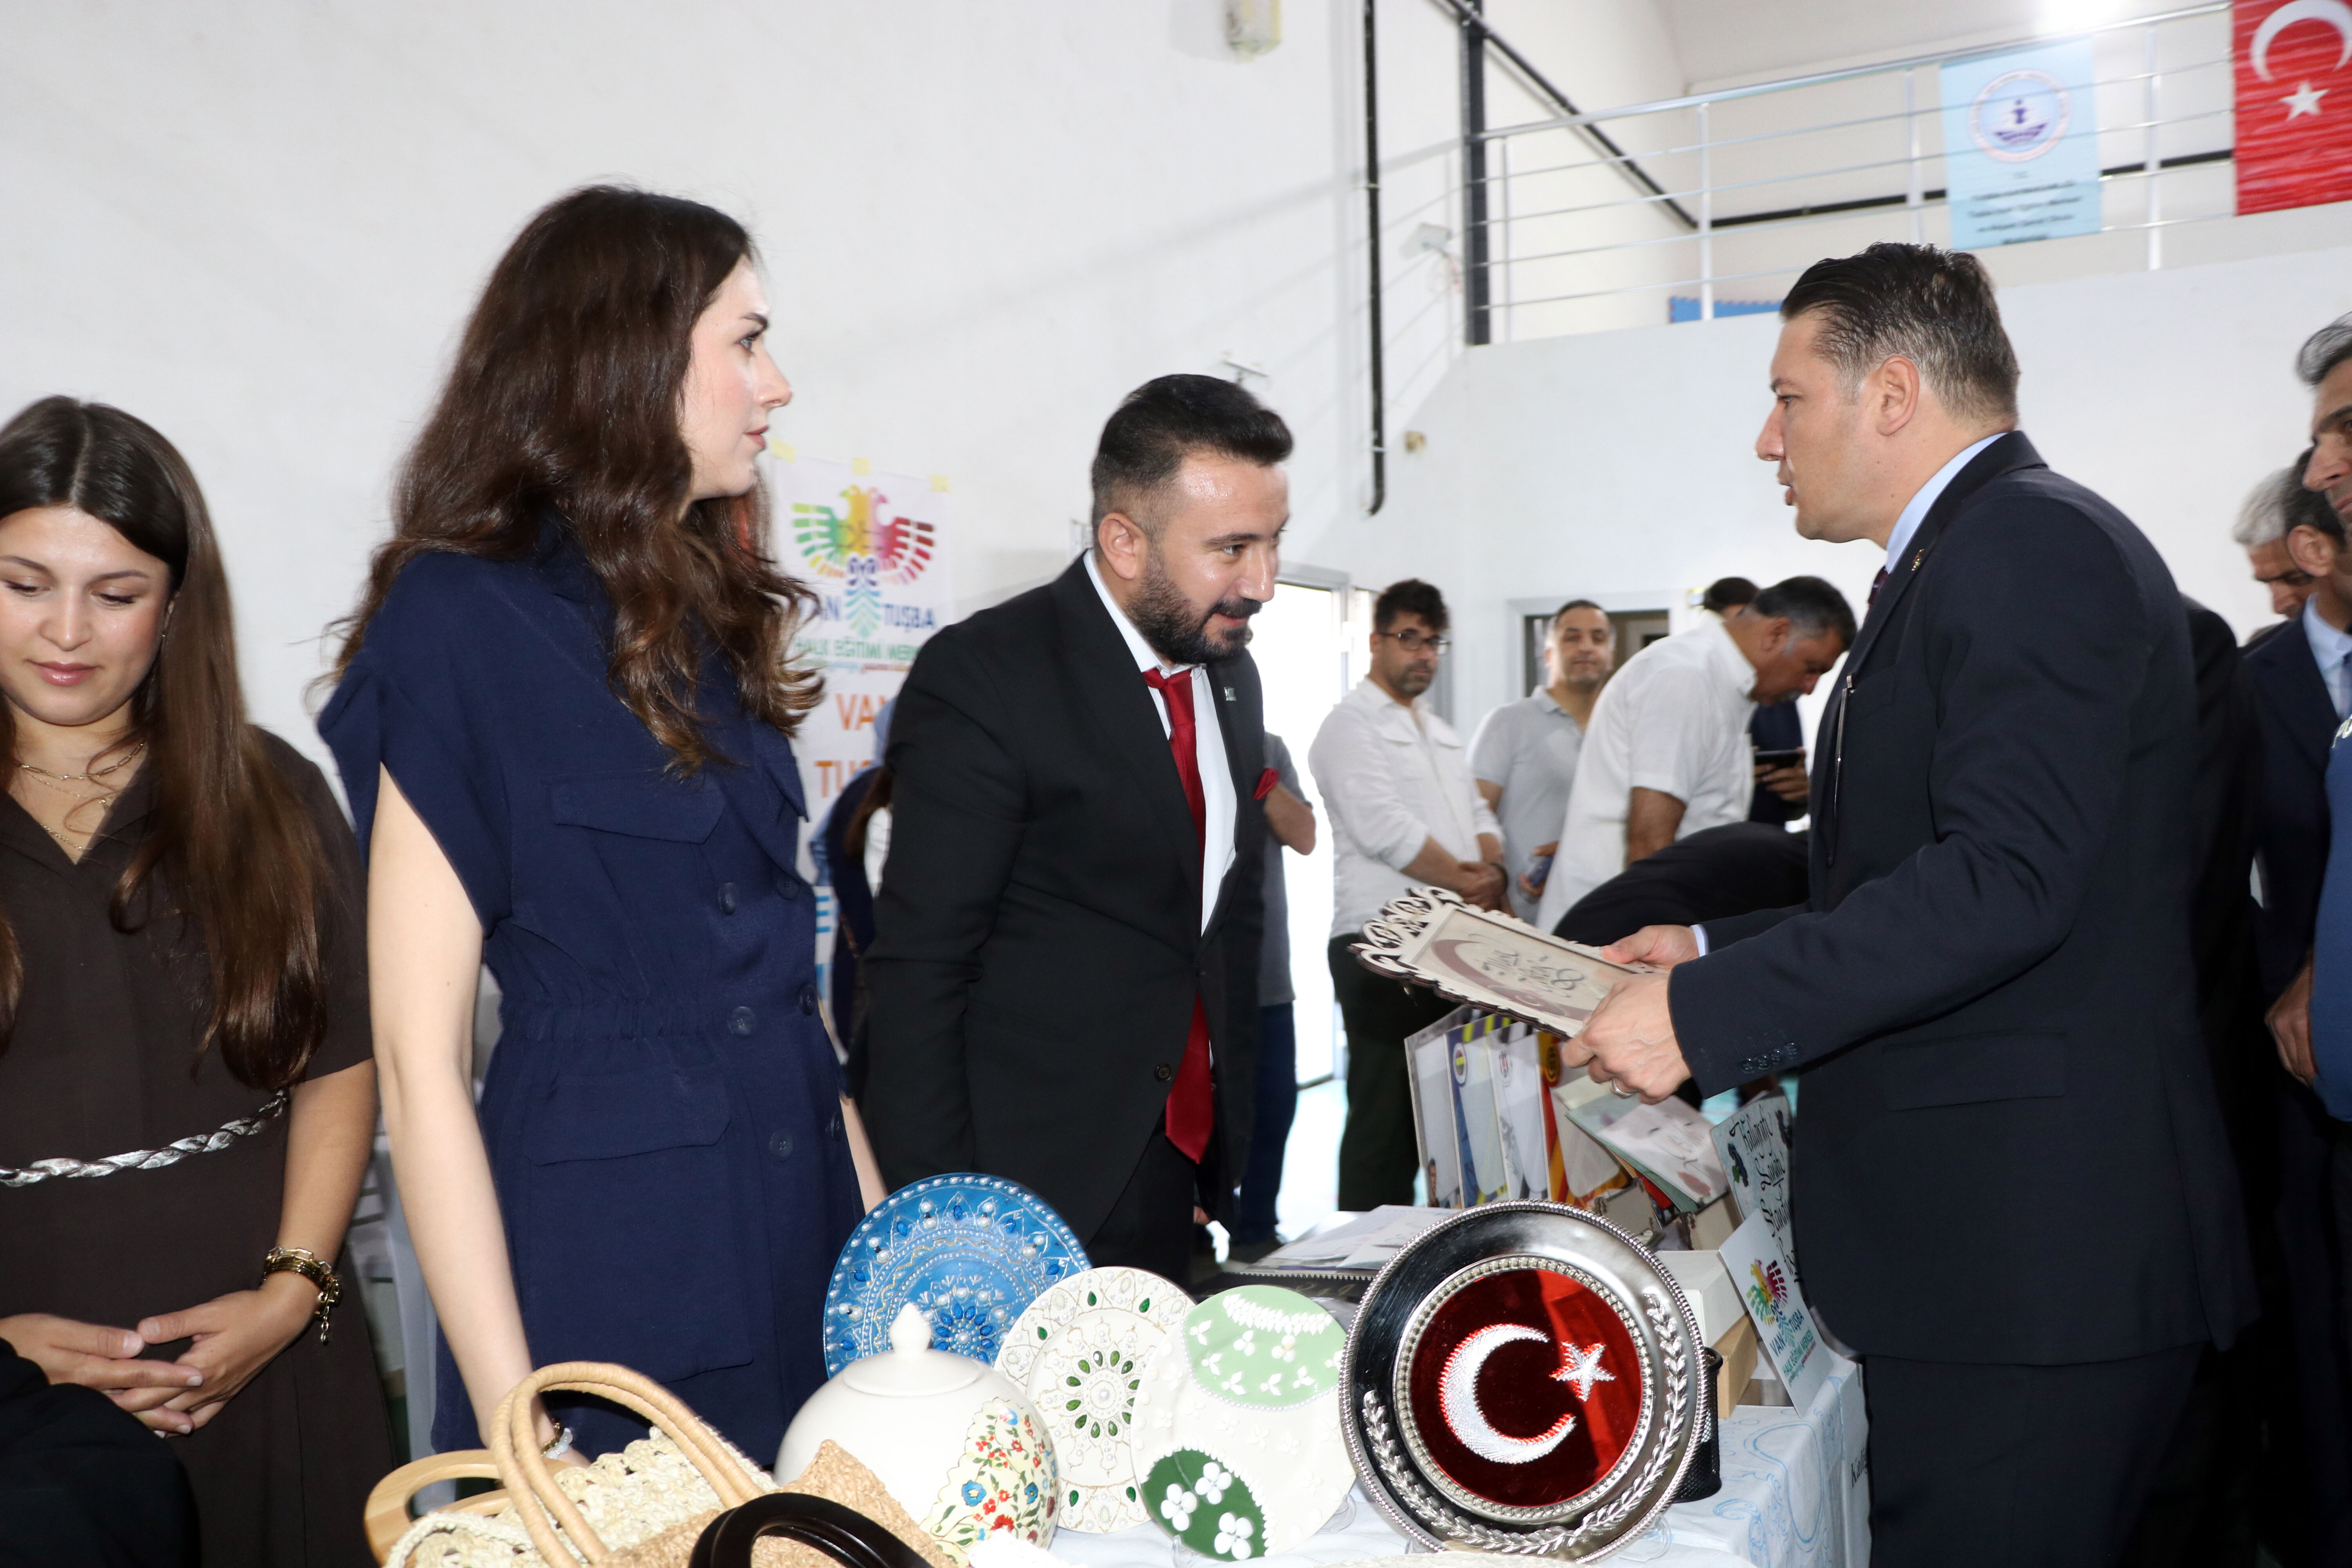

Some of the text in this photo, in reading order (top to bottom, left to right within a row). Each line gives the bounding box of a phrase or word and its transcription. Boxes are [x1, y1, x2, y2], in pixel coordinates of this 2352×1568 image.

[1769, 1331, 1786, 1357] VAN
[1788, 1308, 1805, 1333] TUŞBA
[1782, 1358, 1794, 1377] HALK
